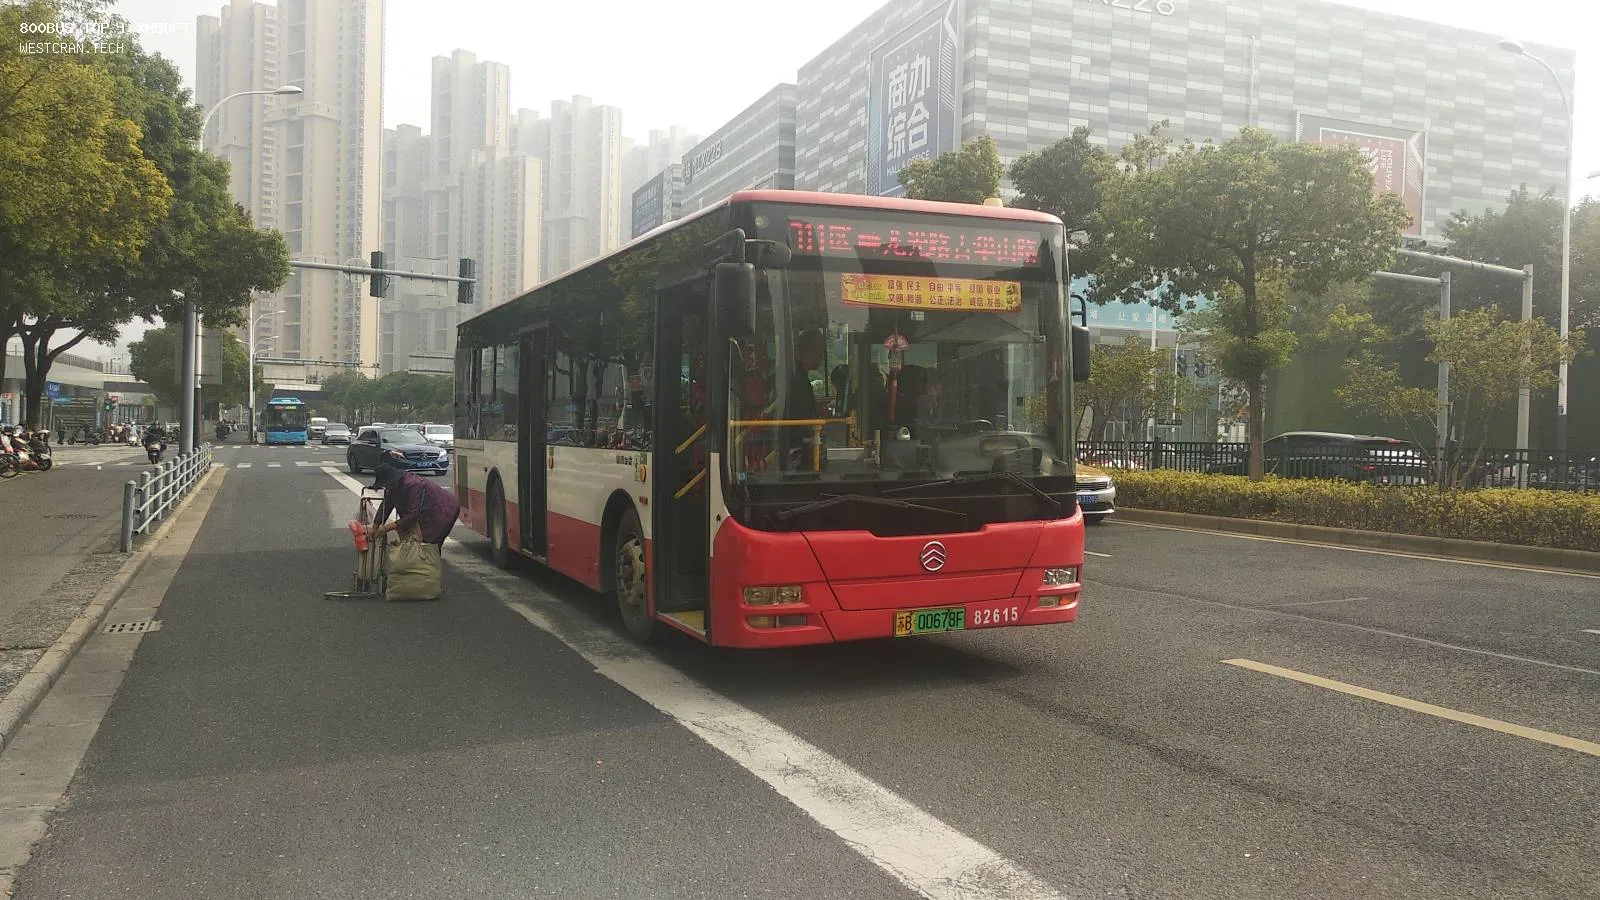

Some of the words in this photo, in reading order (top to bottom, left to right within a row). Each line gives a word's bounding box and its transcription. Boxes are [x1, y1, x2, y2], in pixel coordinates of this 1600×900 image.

[888, 53, 930, 114] 商办
[887, 102, 929, 161] 综合
[888, 280, 903, 290] 富强
[907, 281, 921, 290] 民主
[929, 282, 943, 292] 自由
[948, 283, 961, 292] 平等
[888, 293, 903, 303] 文明
[907, 294, 921, 304] 和谐
[929, 295, 944, 305] 公正
[947, 296, 961, 306] 法治
[974, 606, 1019, 625] 82615
